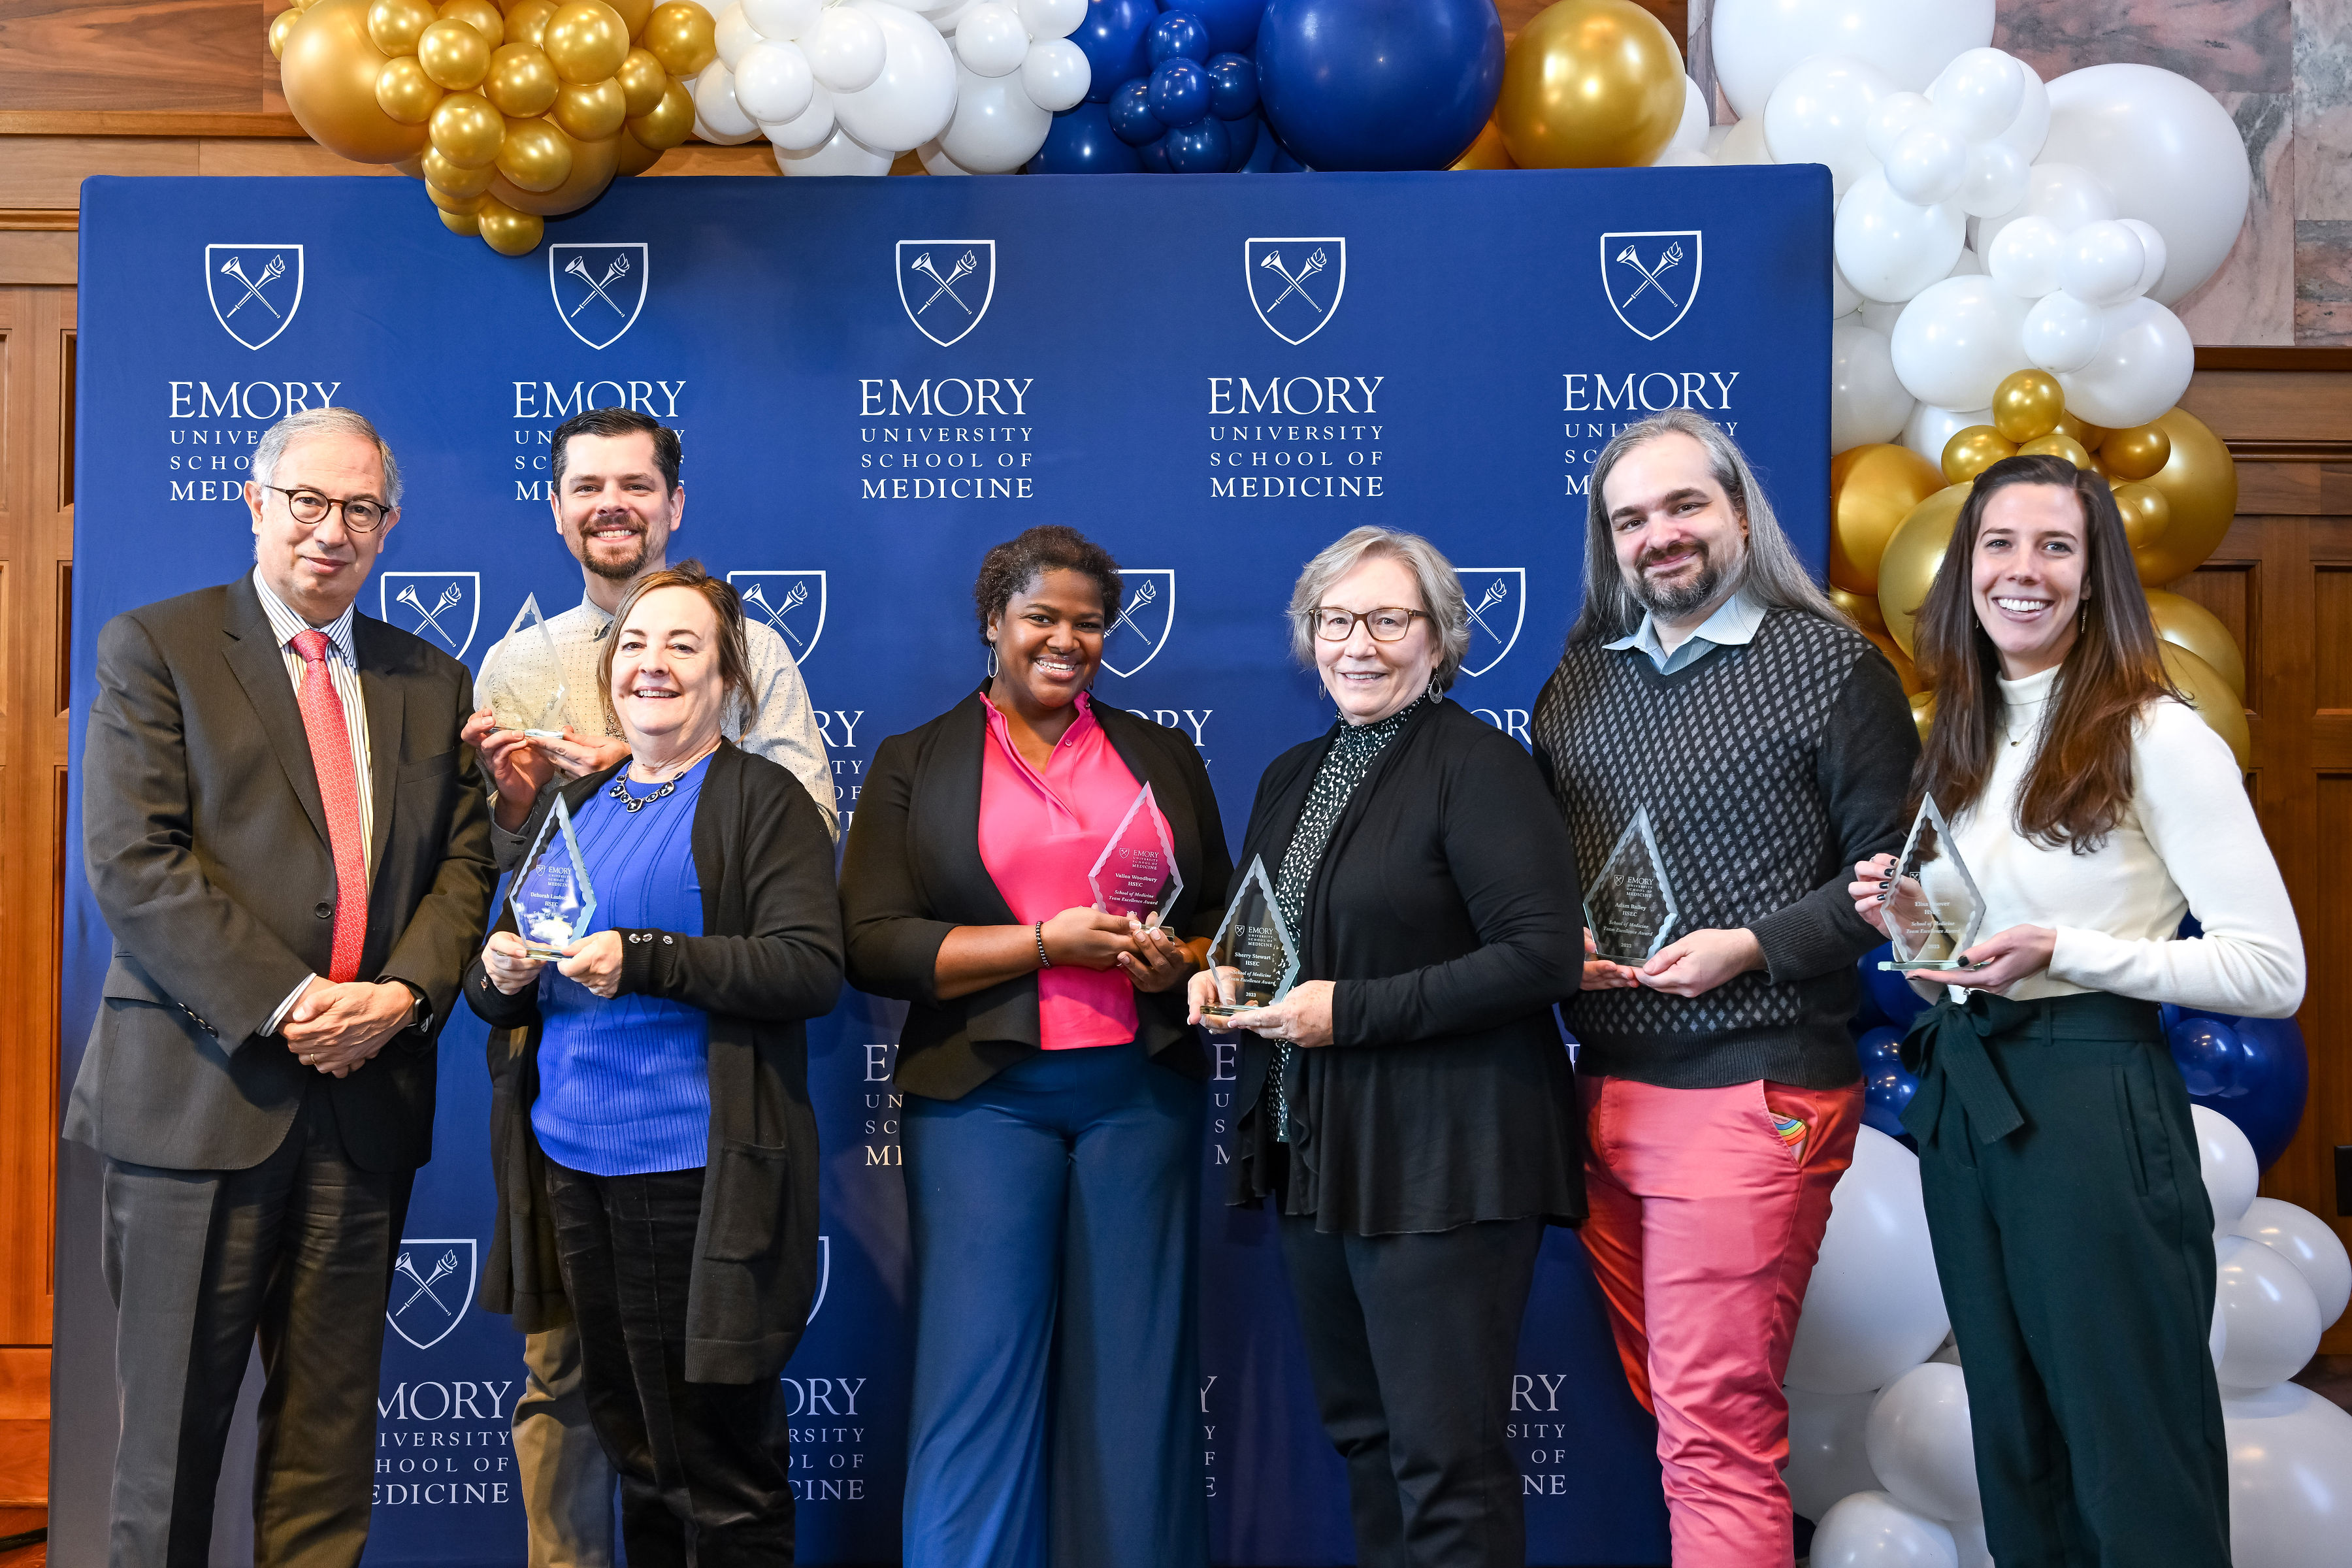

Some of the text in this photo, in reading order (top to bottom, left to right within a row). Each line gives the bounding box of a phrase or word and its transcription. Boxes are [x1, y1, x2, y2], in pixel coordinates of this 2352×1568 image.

[512, 381, 686, 418] EMORY
[858, 378, 1034, 416] EMORY
[1207, 376, 1384, 415] EMORY
[1562, 372, 1740, 411] EMORY
[169, 381, 342, 419] EMORY
[170, 431, 265, 444] UNIVE
[860, 427, 1033, 442] UNIVERSITY
[1209, 425, 1383, 441] UNIVERSITY
[170, 456, 250, 470] SCHO
[861, 453, 1032, 468] SCHOOL OF
[1210, 451, 1382, 466] SCHOOL OF
[861, 478, 1034, 499] MEDICINE
[1210, 476, 1384, 498] MEDICINE
[1134, 849, 1159, 858] EMORY
[378, 1381, 512, 1420] MORY
[781, 1378, 866, 1416] ORY
[380, 1431, 510, 1447] IVERSITY
[789, 1428, 864, 1443] RSITY
[829, 1454, 864, 1469] OF
[1531, 1450, 1565, 1463] OF
[376, 1457, 508, 1473] HOOL OF
[372, 1483, 509, 1505] EDICINE
